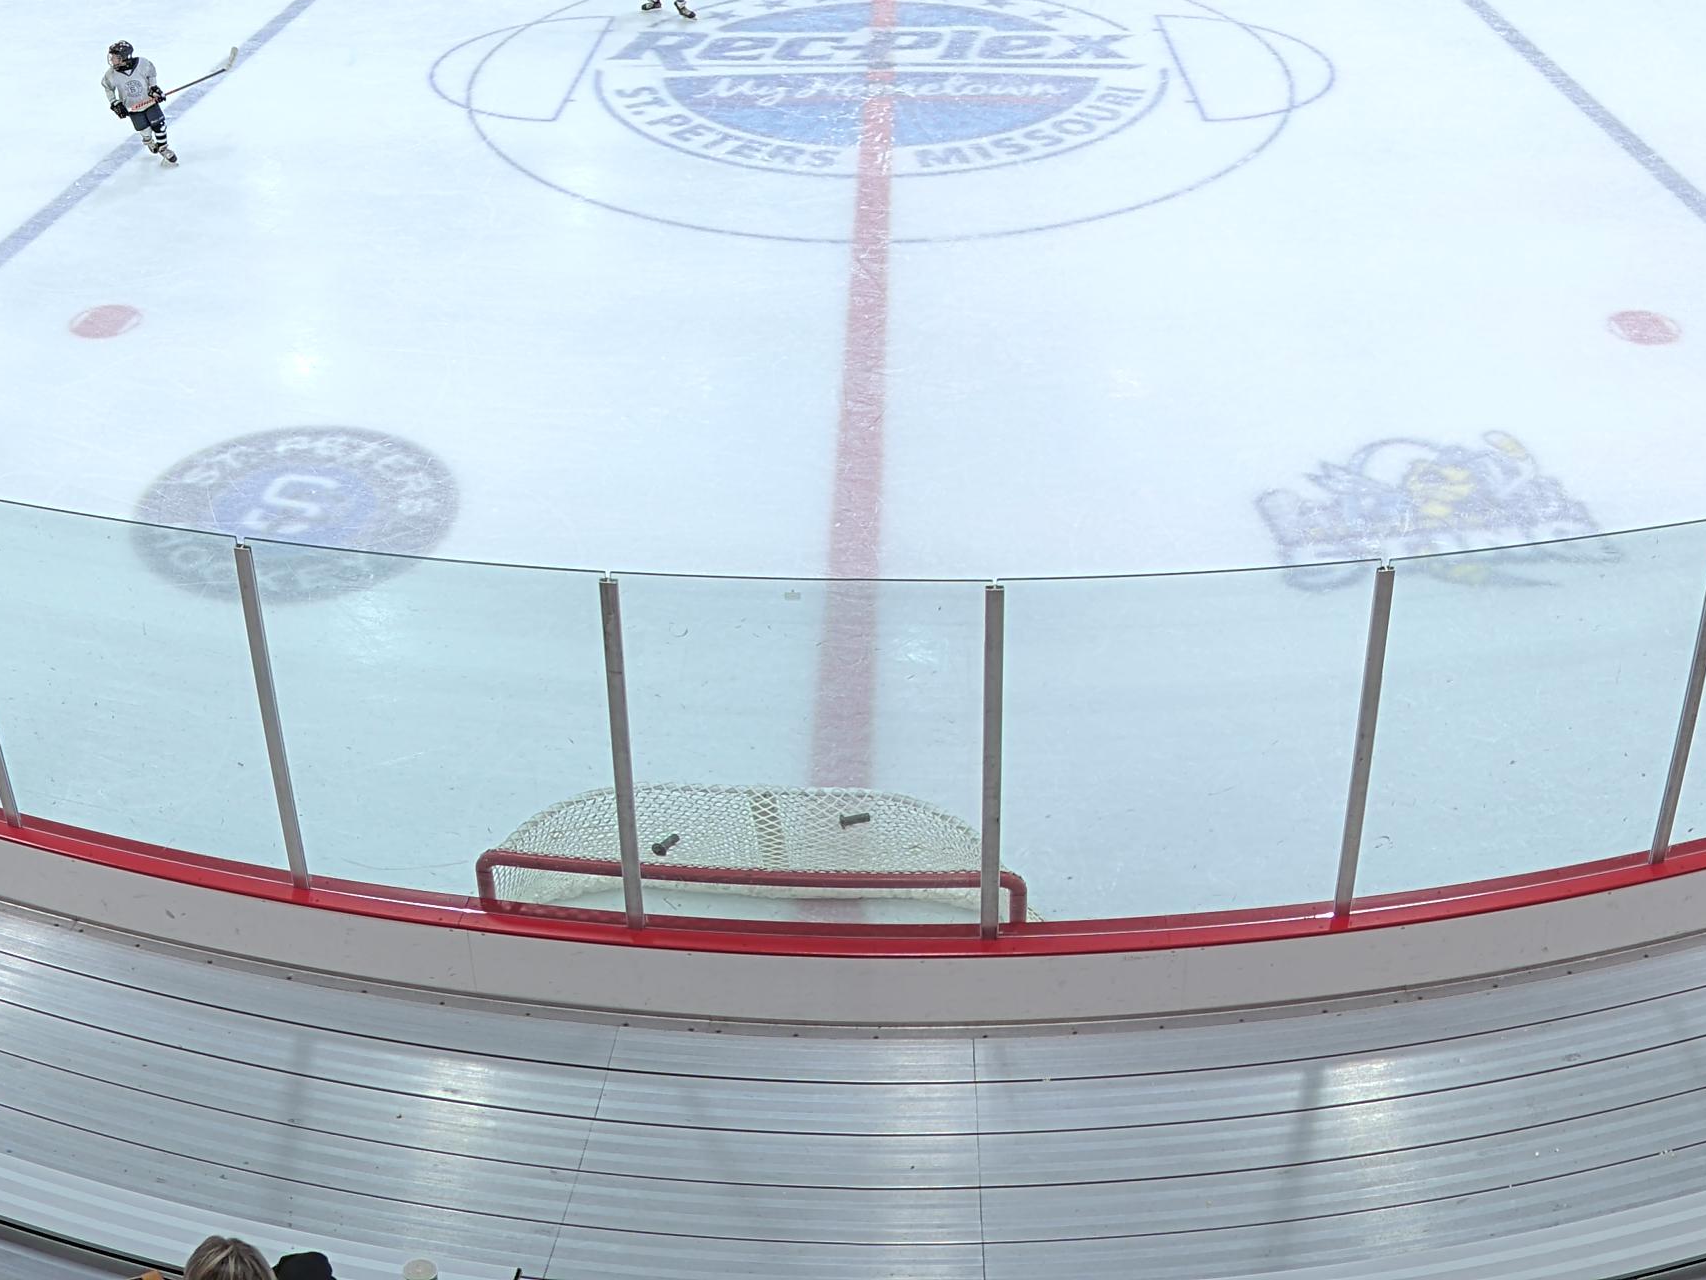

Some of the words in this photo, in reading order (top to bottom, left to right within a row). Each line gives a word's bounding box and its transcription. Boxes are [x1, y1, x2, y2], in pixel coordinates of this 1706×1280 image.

[693, 77, 785, 106] My
[800, 75, 1069, 99] Hometown
[647, 114, 842, 170] PETERS
[913, 86, 1149, 169] MISSOURI
